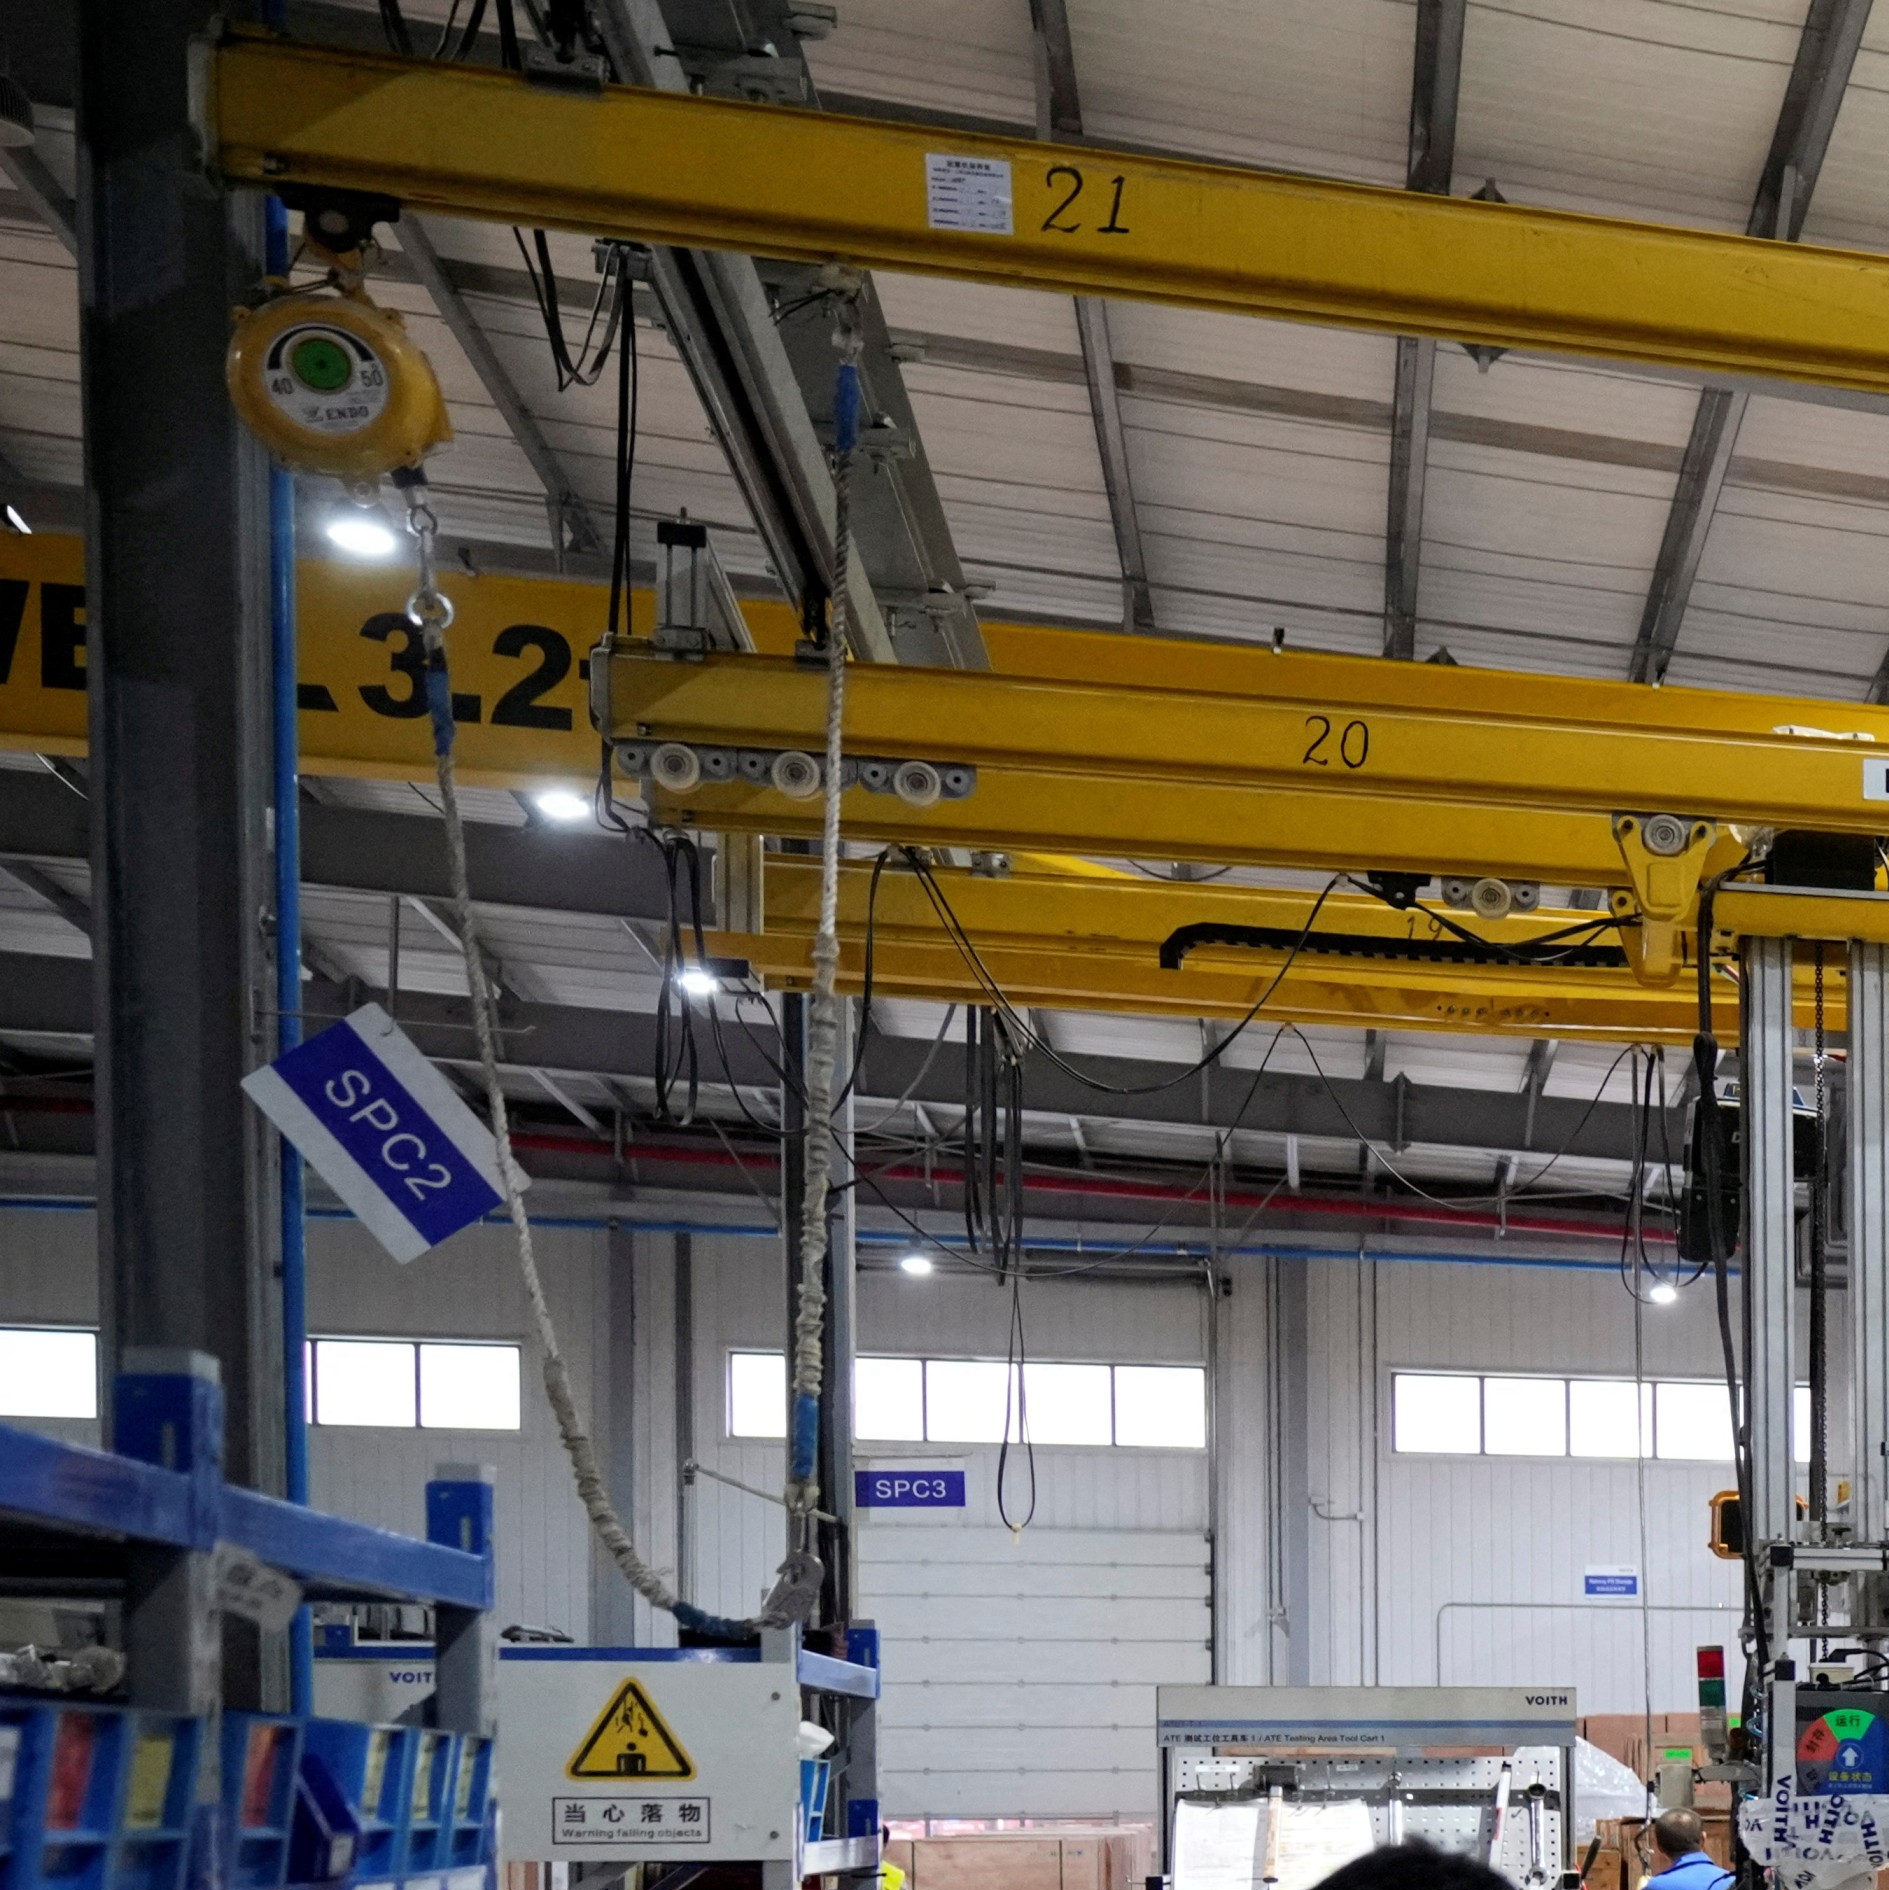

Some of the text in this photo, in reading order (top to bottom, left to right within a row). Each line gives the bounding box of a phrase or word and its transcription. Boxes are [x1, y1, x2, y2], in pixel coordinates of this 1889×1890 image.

[1040, 166, 1130, 234] 21
[271, 377, 294, 395] 40
[360, 369, 384, 388] 50
[325, 406, 370, 421] ENDO
[357, 611, 590, 732] 3.2
[1302, 715, 1370, 768] 20
[1407, 915, 1443, 941] 19
[325, 1068, 453, 1202] SPC2
[874, 1478, 947, 1500] SPC3
[389, 1671, 433, 1684] VOIT
[1525, 1695, 1568, 1706] VOITH
[1163, 1735, 1181, 1743] ATE
[1264, 1735, 1281, 1743] ATE
[1284, 1734, 1316, 1744] Testing
[1318, 1735, 1338, 1743] Area
[1340, 1735, 1358, 1743] Tool
[1360, 1735, 1379, 1743] Cart
[563, 1802, 701, 1823] 当心落物
[1774, 1775, 1792, 1842] VOITH
[1818, 1793, 1845, 1844] OITH
[561, 1828, 702, 1839] Warning falling objects
